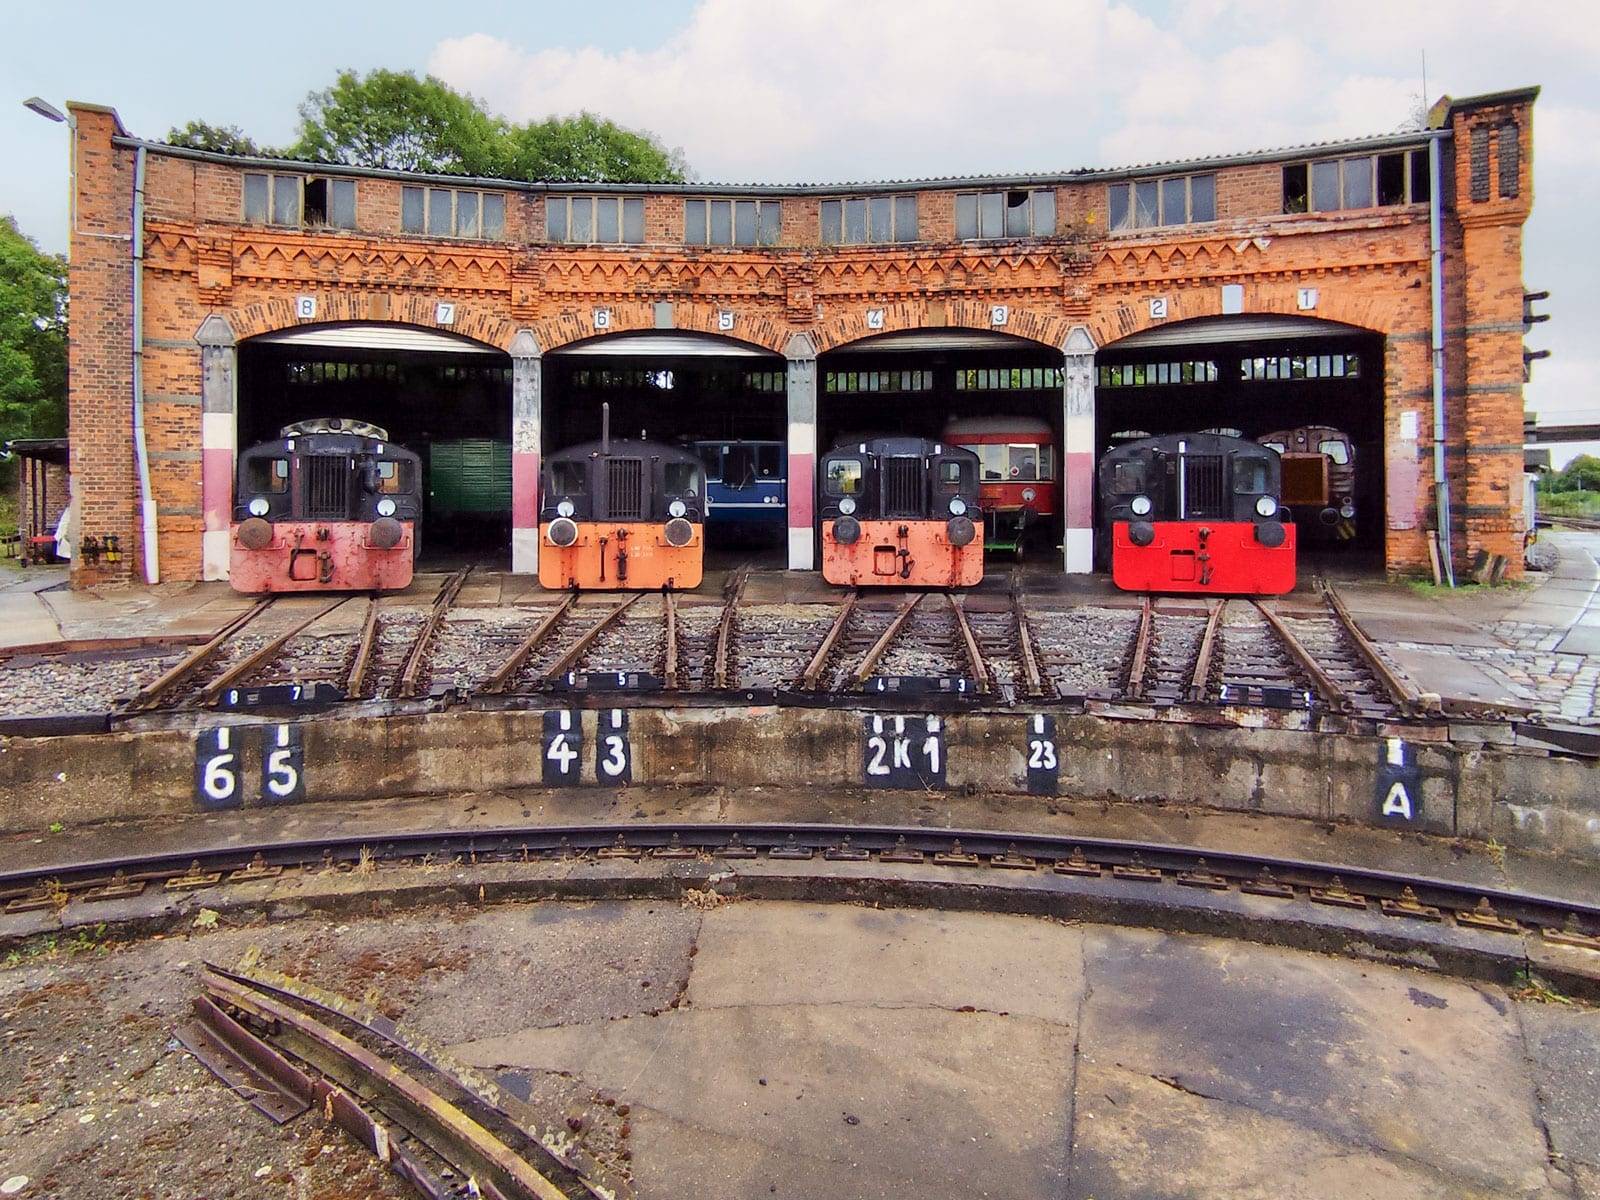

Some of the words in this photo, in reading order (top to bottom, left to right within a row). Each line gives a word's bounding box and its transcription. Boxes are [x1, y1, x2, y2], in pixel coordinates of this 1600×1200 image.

[302, 300, 312, 315] 8
[441, 307, 450, 321] 7
[995, 308, 1004, 322] 3
[1152, 300, 1163, 315] 2
[597, 311, 606, 325] 6
[721, 312, 730, 327] 5
[870, 311, 880, 325] 4
[568, 672, 576, 685] 6
[618, 672, 626, 685] 5
[877, 678, 885, 691] 4
[958, 679, 966, 692] 3
[230, 690, 239, 705] 8
[292, 687, 301, 700] 7
[1219, 685, 1228, 700] 2
[547, 734, 578, 774] 4
[602, 735, 626, 775] 3
[1028, 740, 1057, 770] 23
[204, 753, 234, 800] 6
[269, 750, 298, 797] 5
[1382, 782, 1412, 820] A
